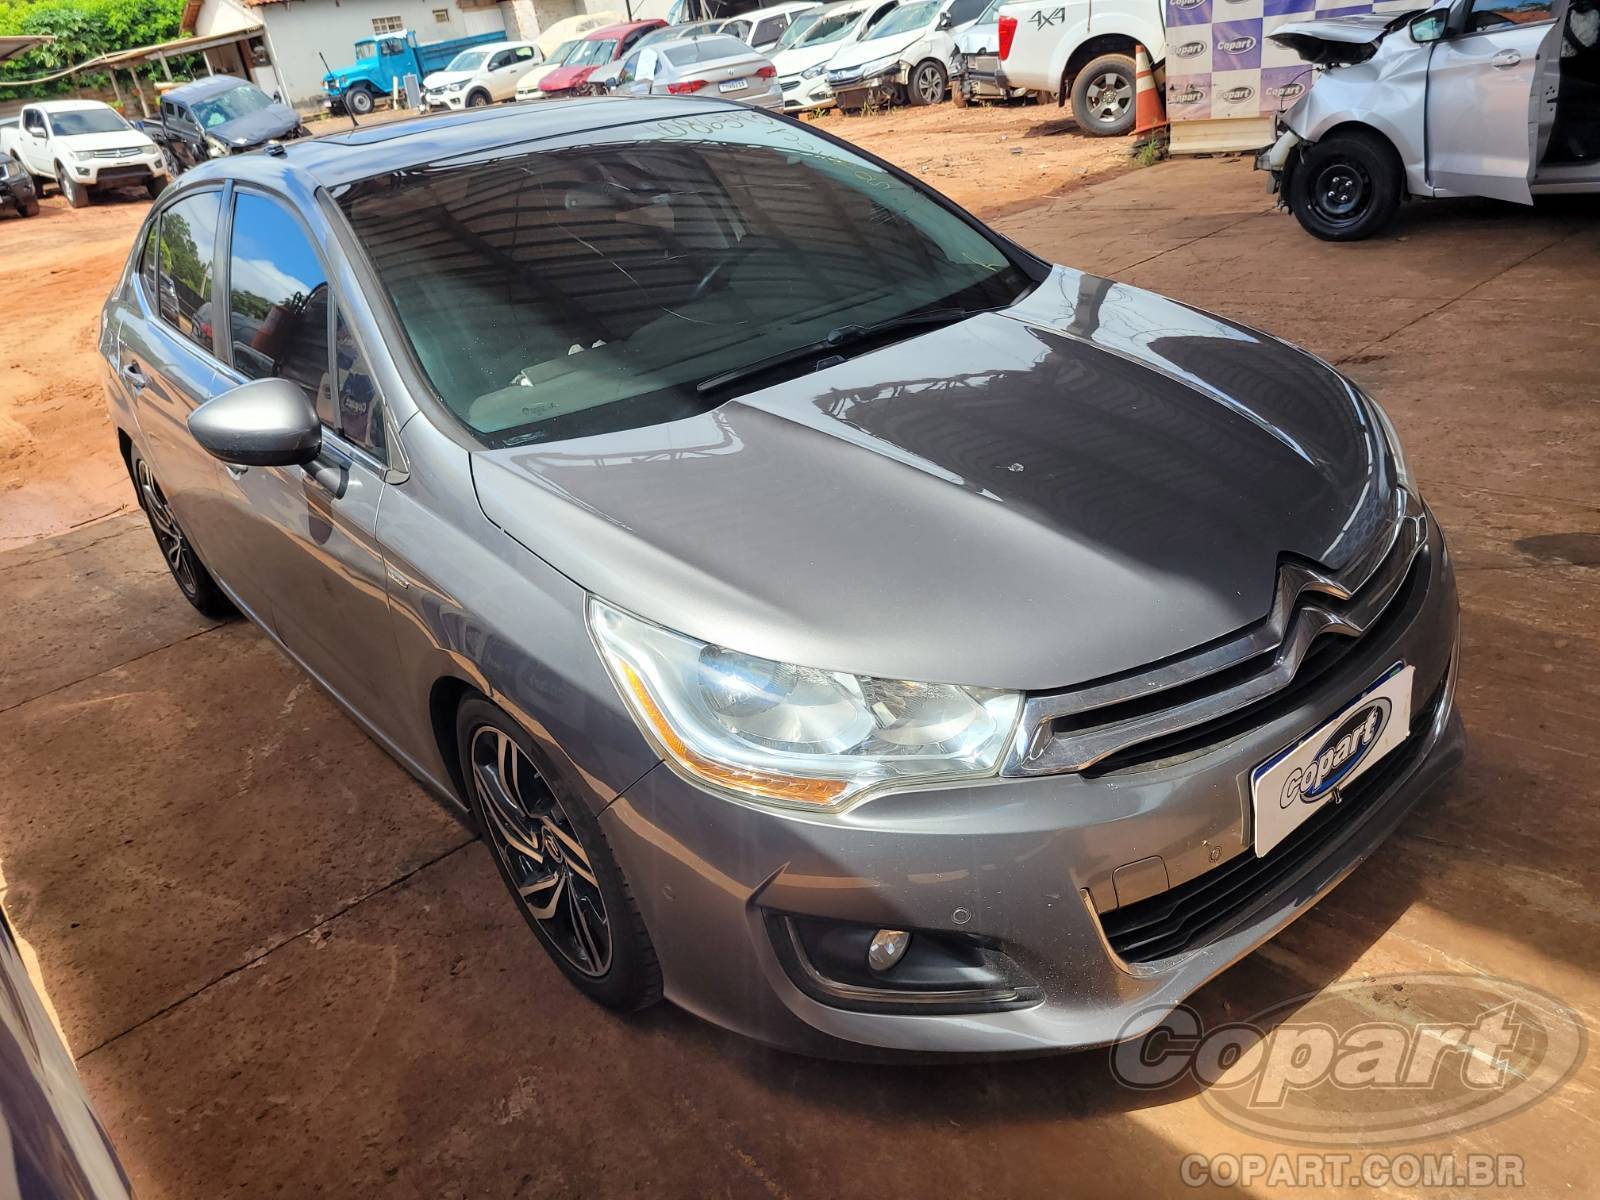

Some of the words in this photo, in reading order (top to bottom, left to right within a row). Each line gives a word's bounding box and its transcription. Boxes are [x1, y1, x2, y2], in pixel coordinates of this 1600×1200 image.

[1169, 44, 1202, 56] opart
[1217, 38, 1252, 51] Copart
[1216, 88, 1249, 100] opart
[1265, 85, 1301, 97] Copart
[1279, 706, 1379, 809] Copart
